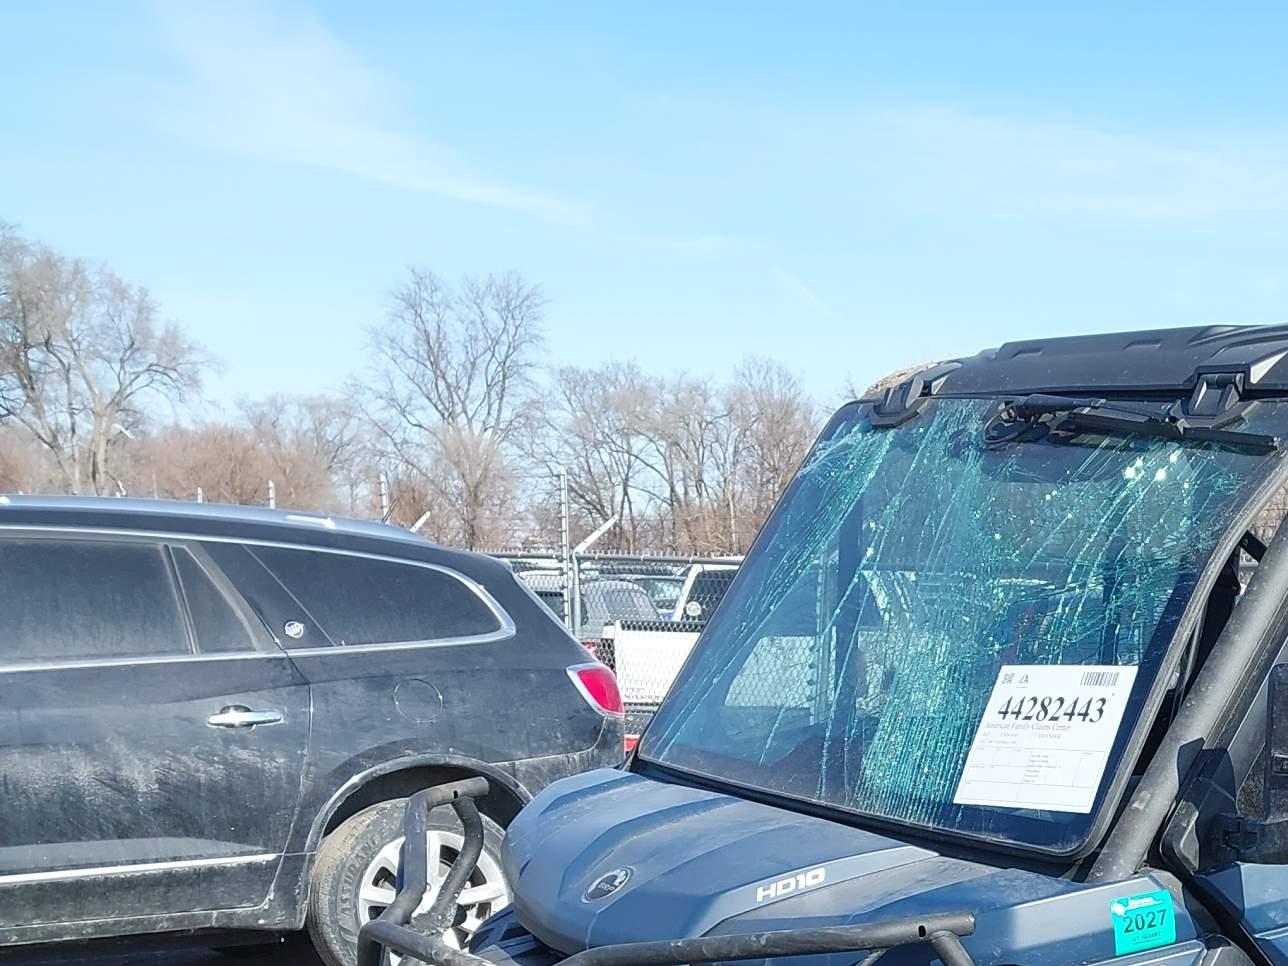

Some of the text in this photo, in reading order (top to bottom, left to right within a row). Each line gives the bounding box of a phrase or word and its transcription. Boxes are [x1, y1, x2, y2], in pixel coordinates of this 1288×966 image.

[997, 695, 1107, 723] 44282443
[756, 867, 826, 902] HD10
[1123, 908, 1167, 934] 2027
